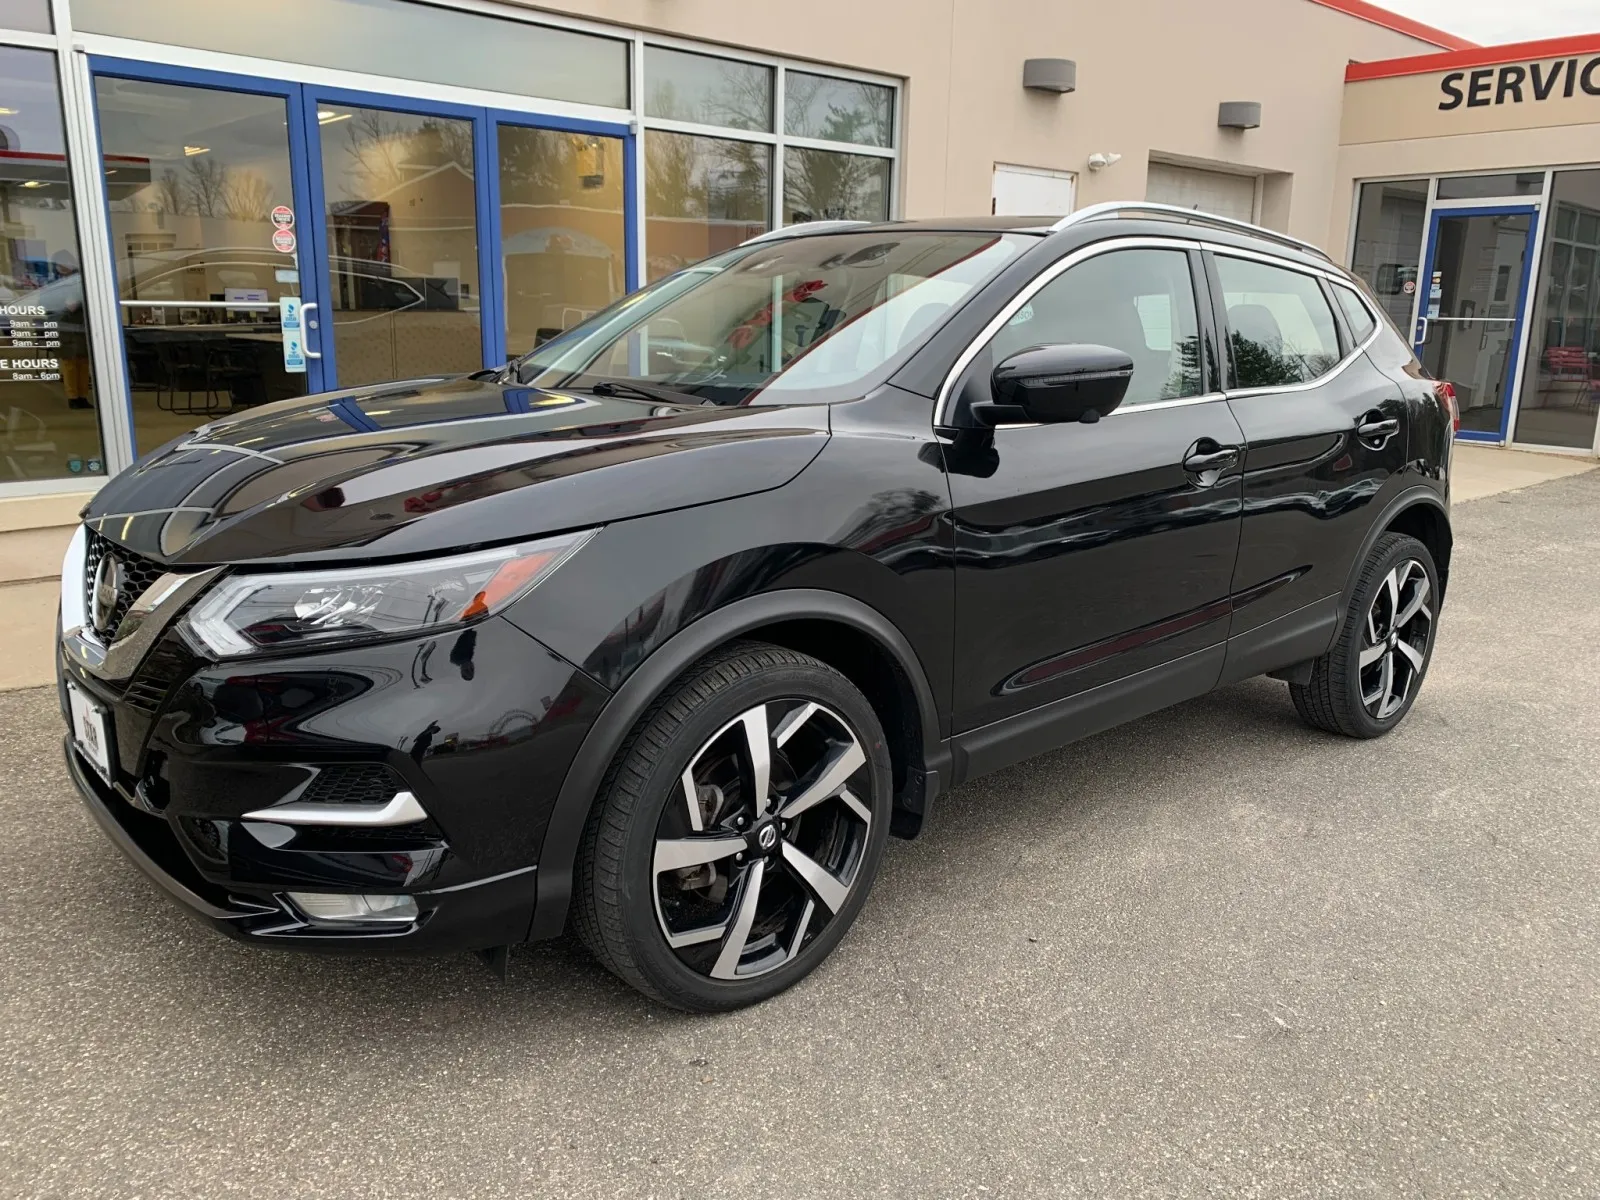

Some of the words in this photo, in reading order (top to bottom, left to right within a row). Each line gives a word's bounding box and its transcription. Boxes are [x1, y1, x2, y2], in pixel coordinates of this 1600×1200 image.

[1438, 57, 1600, 110] SERVIC
[0, 305, 45, 315] HOURS
[9, 320, 30, 328] 9am
[10, 329, 31, 338] 9am
[12, 339, 33, 348] 9am
[12, 358, 59, 369] HOURS
[40, 372, 60, 381] 6pm
